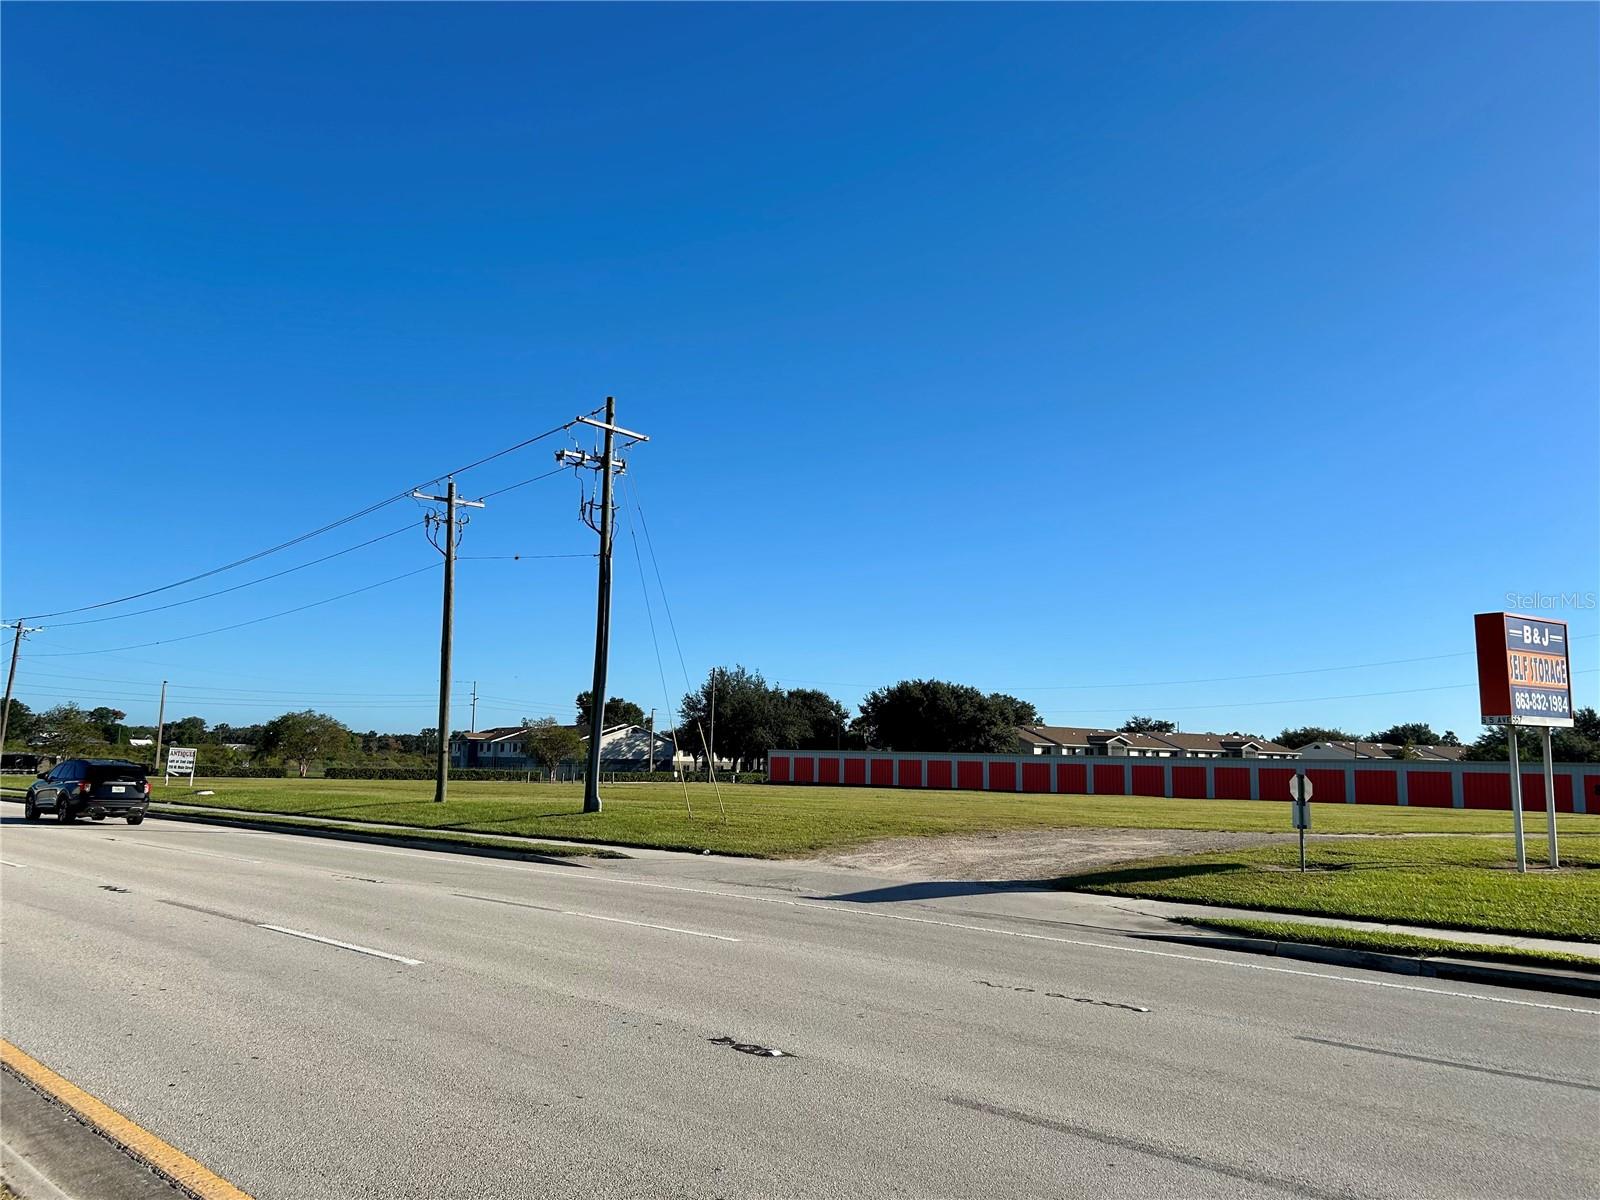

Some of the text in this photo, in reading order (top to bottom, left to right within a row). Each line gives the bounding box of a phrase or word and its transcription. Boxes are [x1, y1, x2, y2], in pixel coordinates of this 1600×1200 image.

[1510, 654, 1567, 686] SELF STORAGE
[1515, 692, 1568, 713] 863-832-1984
